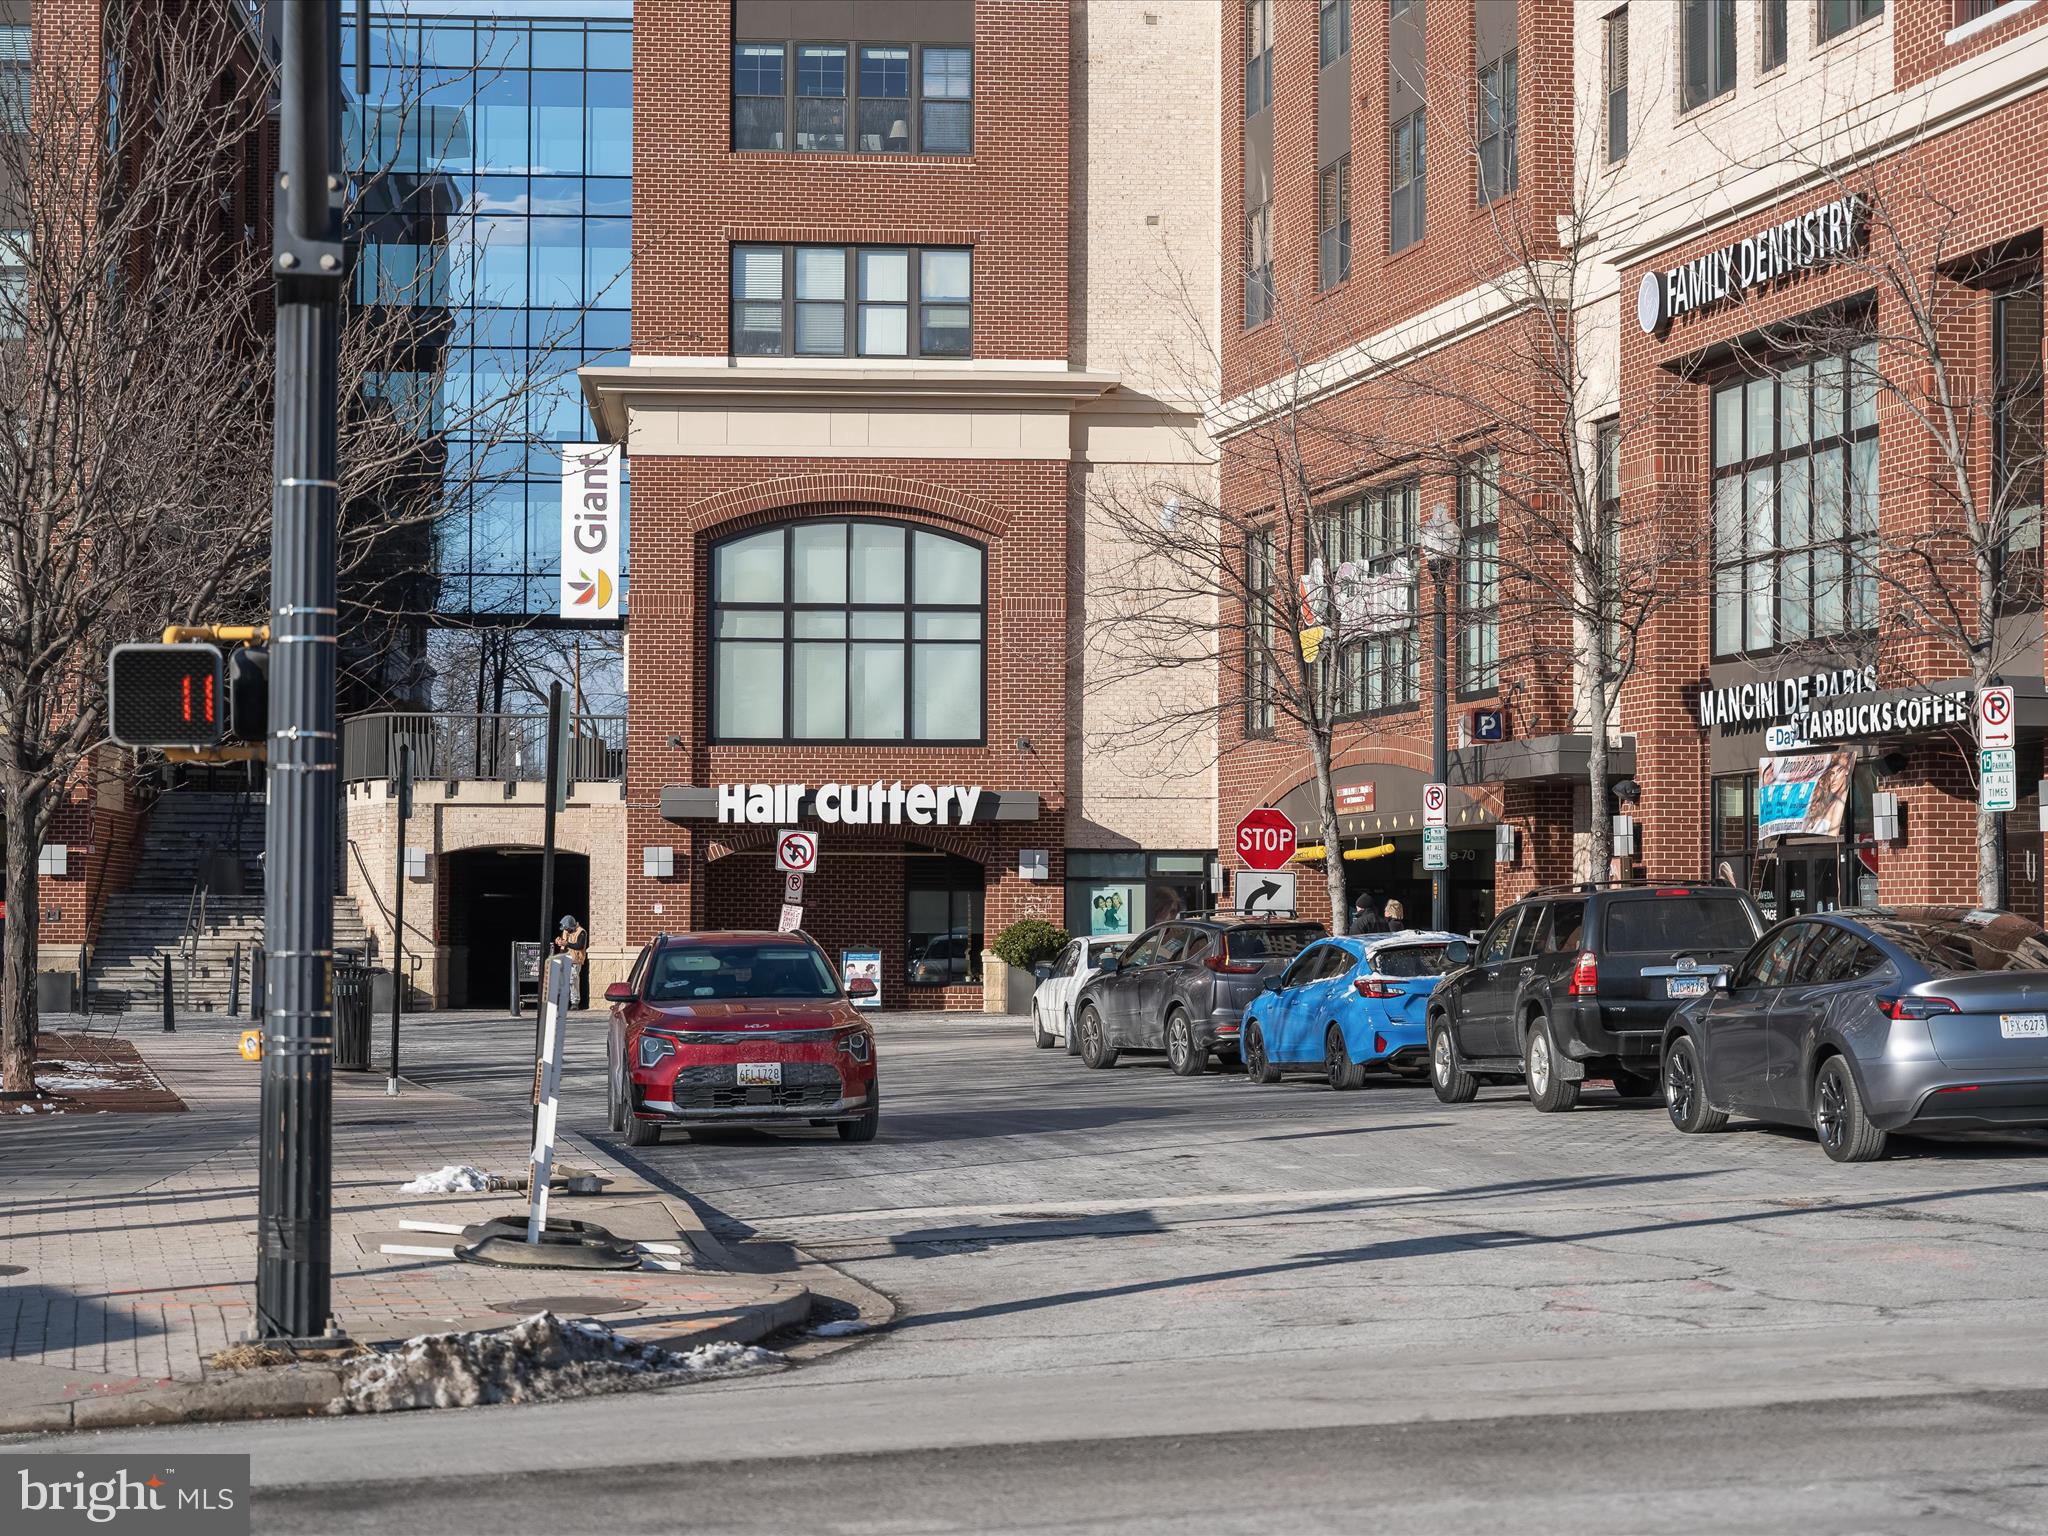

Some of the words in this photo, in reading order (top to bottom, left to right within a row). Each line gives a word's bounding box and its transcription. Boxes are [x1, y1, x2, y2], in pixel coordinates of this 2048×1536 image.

[1667, 244, 1734, 317] FAMILY
[1741, 196, 1857, 288] DENTISTRY
[574, 453, 608, 554] Giant
[1700, 683, 1779, 727] MANCINI
[1784, 675, 1810, 715] DE
[1816, 664, 1878, 698] PARIS
[1480, 715, 1496, 736] P
[1791, 702, 1893, 739] STARBUCKS
[1896, 690, 1968, 729] COFFEE
[1982, 753, 1992, 770] 15
[1985, 775, 1995, 784] AT
[1998, 774, 2011, 783] ALL
[718, 783, 805, 823] Hair
[1988, 787, 2009, 797] TIMES
[1239, 827, 1293, 851] STOP
[1790, 889, 1805, 898] AVEDA
